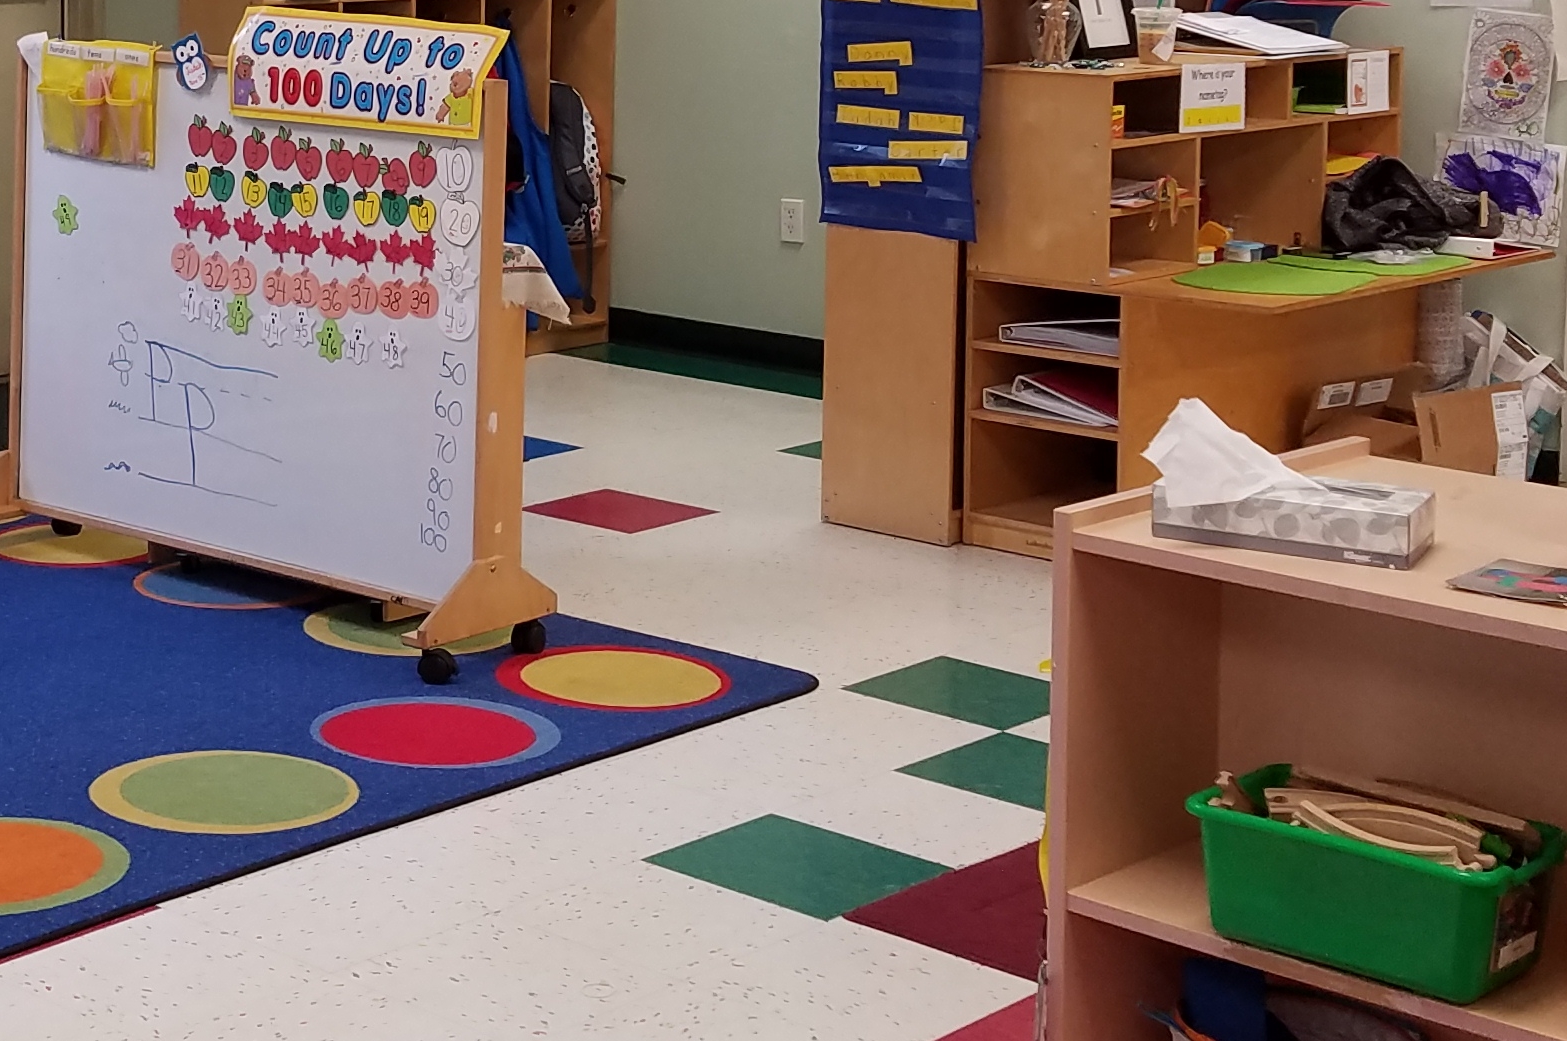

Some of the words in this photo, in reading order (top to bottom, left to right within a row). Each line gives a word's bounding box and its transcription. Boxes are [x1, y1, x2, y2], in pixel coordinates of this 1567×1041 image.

[252, 20, 353, 61] Count
[364, 29, 412, 73] Up
[427, 36, 465, 69] to
[268, 66, 322, 107] 100
[329, 72, 427, 122] Days!
[444, 152, 466, 189] 10
[192, 172, 205, 195] 11
[249, 182, 261, 203] 13
[275, 193, 287, 211] 14
[300, 191, 313, 213] 15
[330, 194, 343, 214] 16
[361, 198, 375, 220] 17
[389, 202, 401, 220] 18
[418, 204, 430, 227] 19
[449, 211, 472, 238] 20
[175, 249, 192, 275] 31
[205, 264, 223, 288] 32
[233, 267, 252, 289] 33
[267, 278, 286, 302] 34
[294, 278, 311, 302] 35
[322, 290, 342, 311] 36
[351, 285, 370, 309] 37
[384, 292, 401, 312] 38
[411, 292, 430, 315] 39
[207, 310, 222, 328] 42
[231, 309, 245, 328] 43
[295, 321, 308, 339] 45
[321, 337, 338, 356] 46
[349, 337, 366, 357] 47
[383, 342, 399, 361] 48
[440, 351, 466, 385] 50
[434, 389, 463, 427] 60
[435, 433, 457, 463] 70
[428, 467, 453, 501] 80
[426, 498, 450, 531] 90
[419, 523, 447, 553] 100
